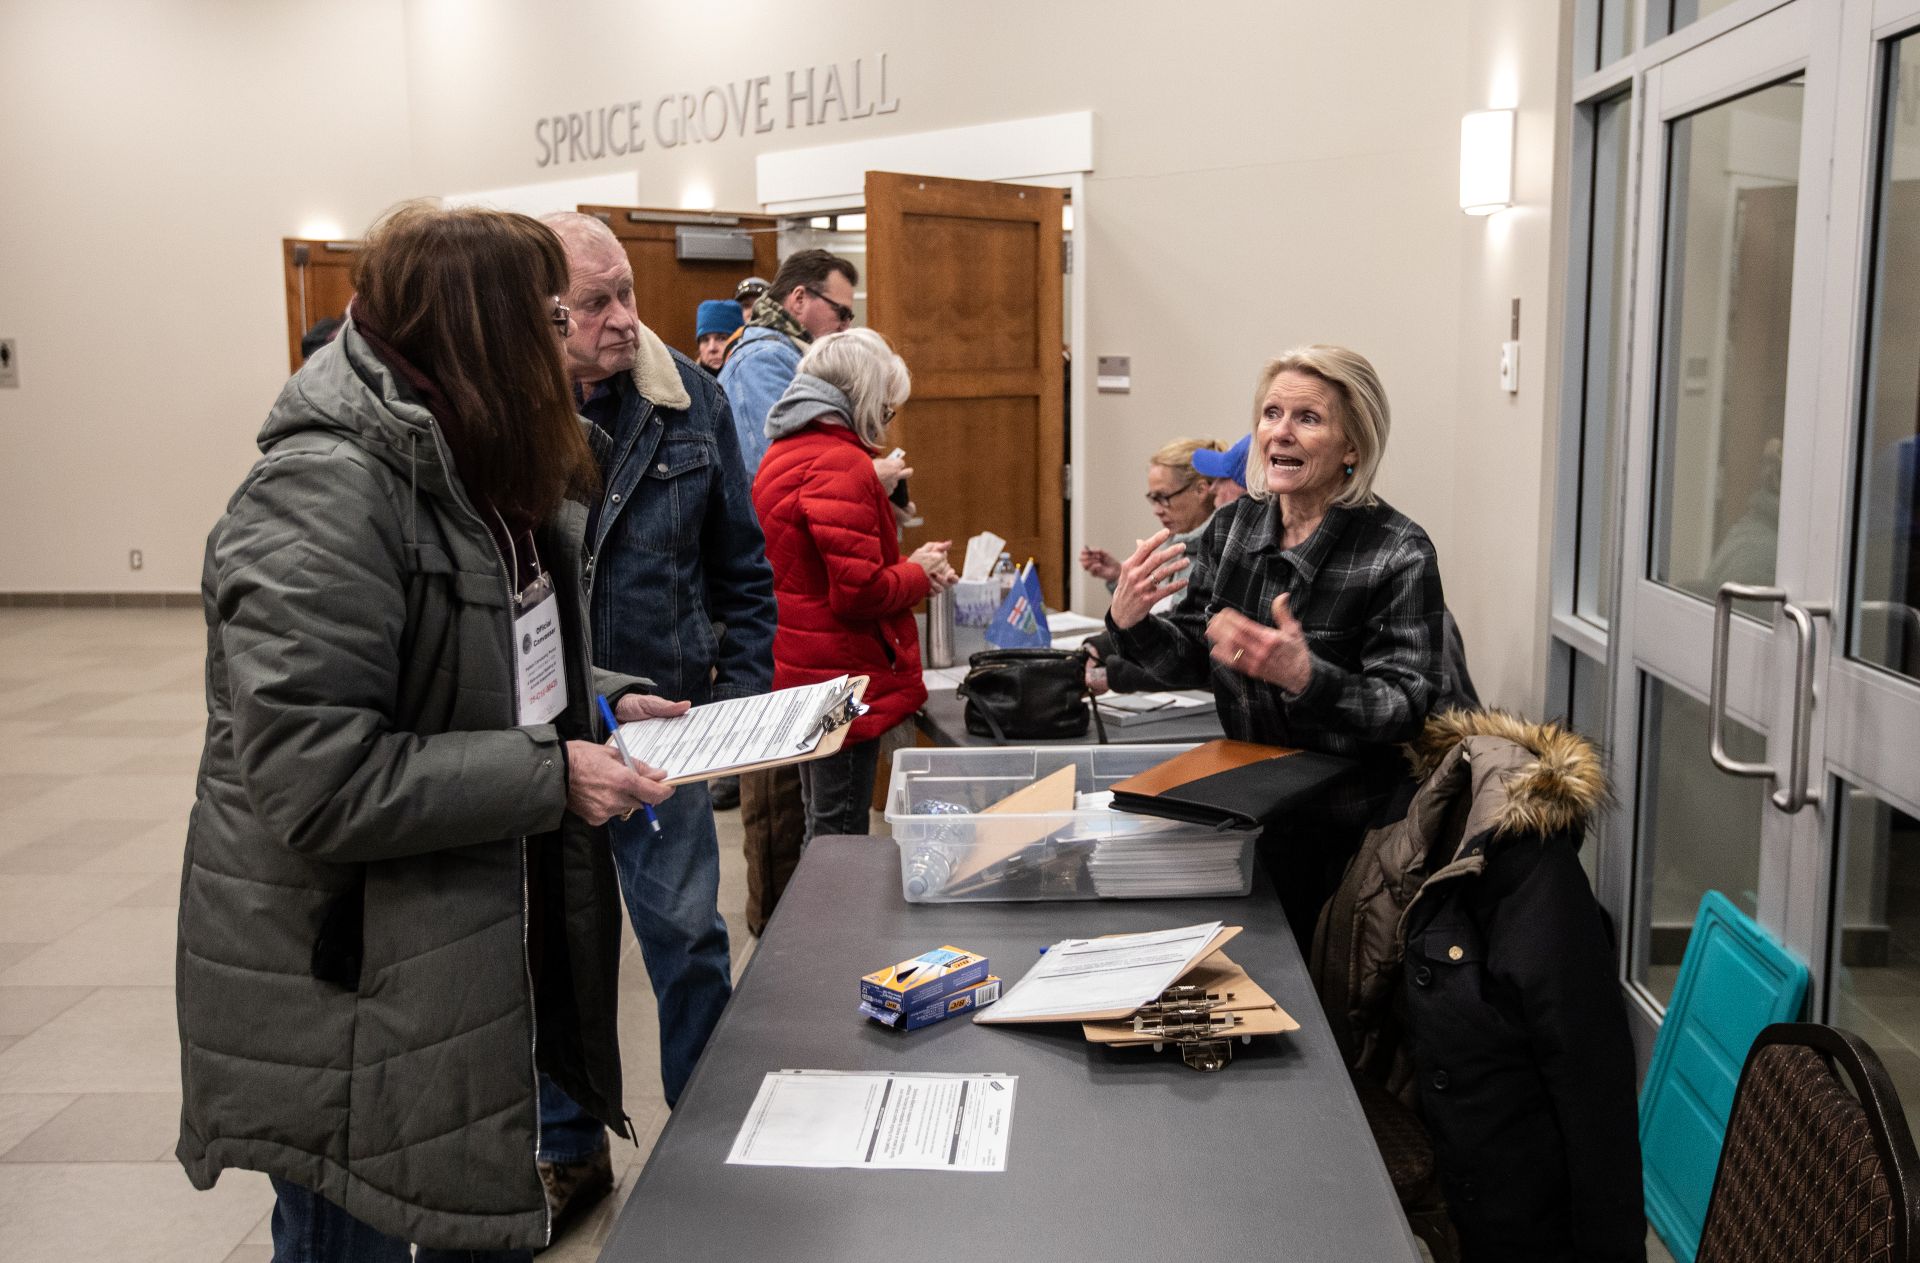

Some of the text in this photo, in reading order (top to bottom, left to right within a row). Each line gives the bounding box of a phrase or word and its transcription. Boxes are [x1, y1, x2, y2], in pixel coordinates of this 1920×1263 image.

[534, 53, 900, 168] SPRUCE GROVE HALL
[949, 999, 967, 1009] BIC
